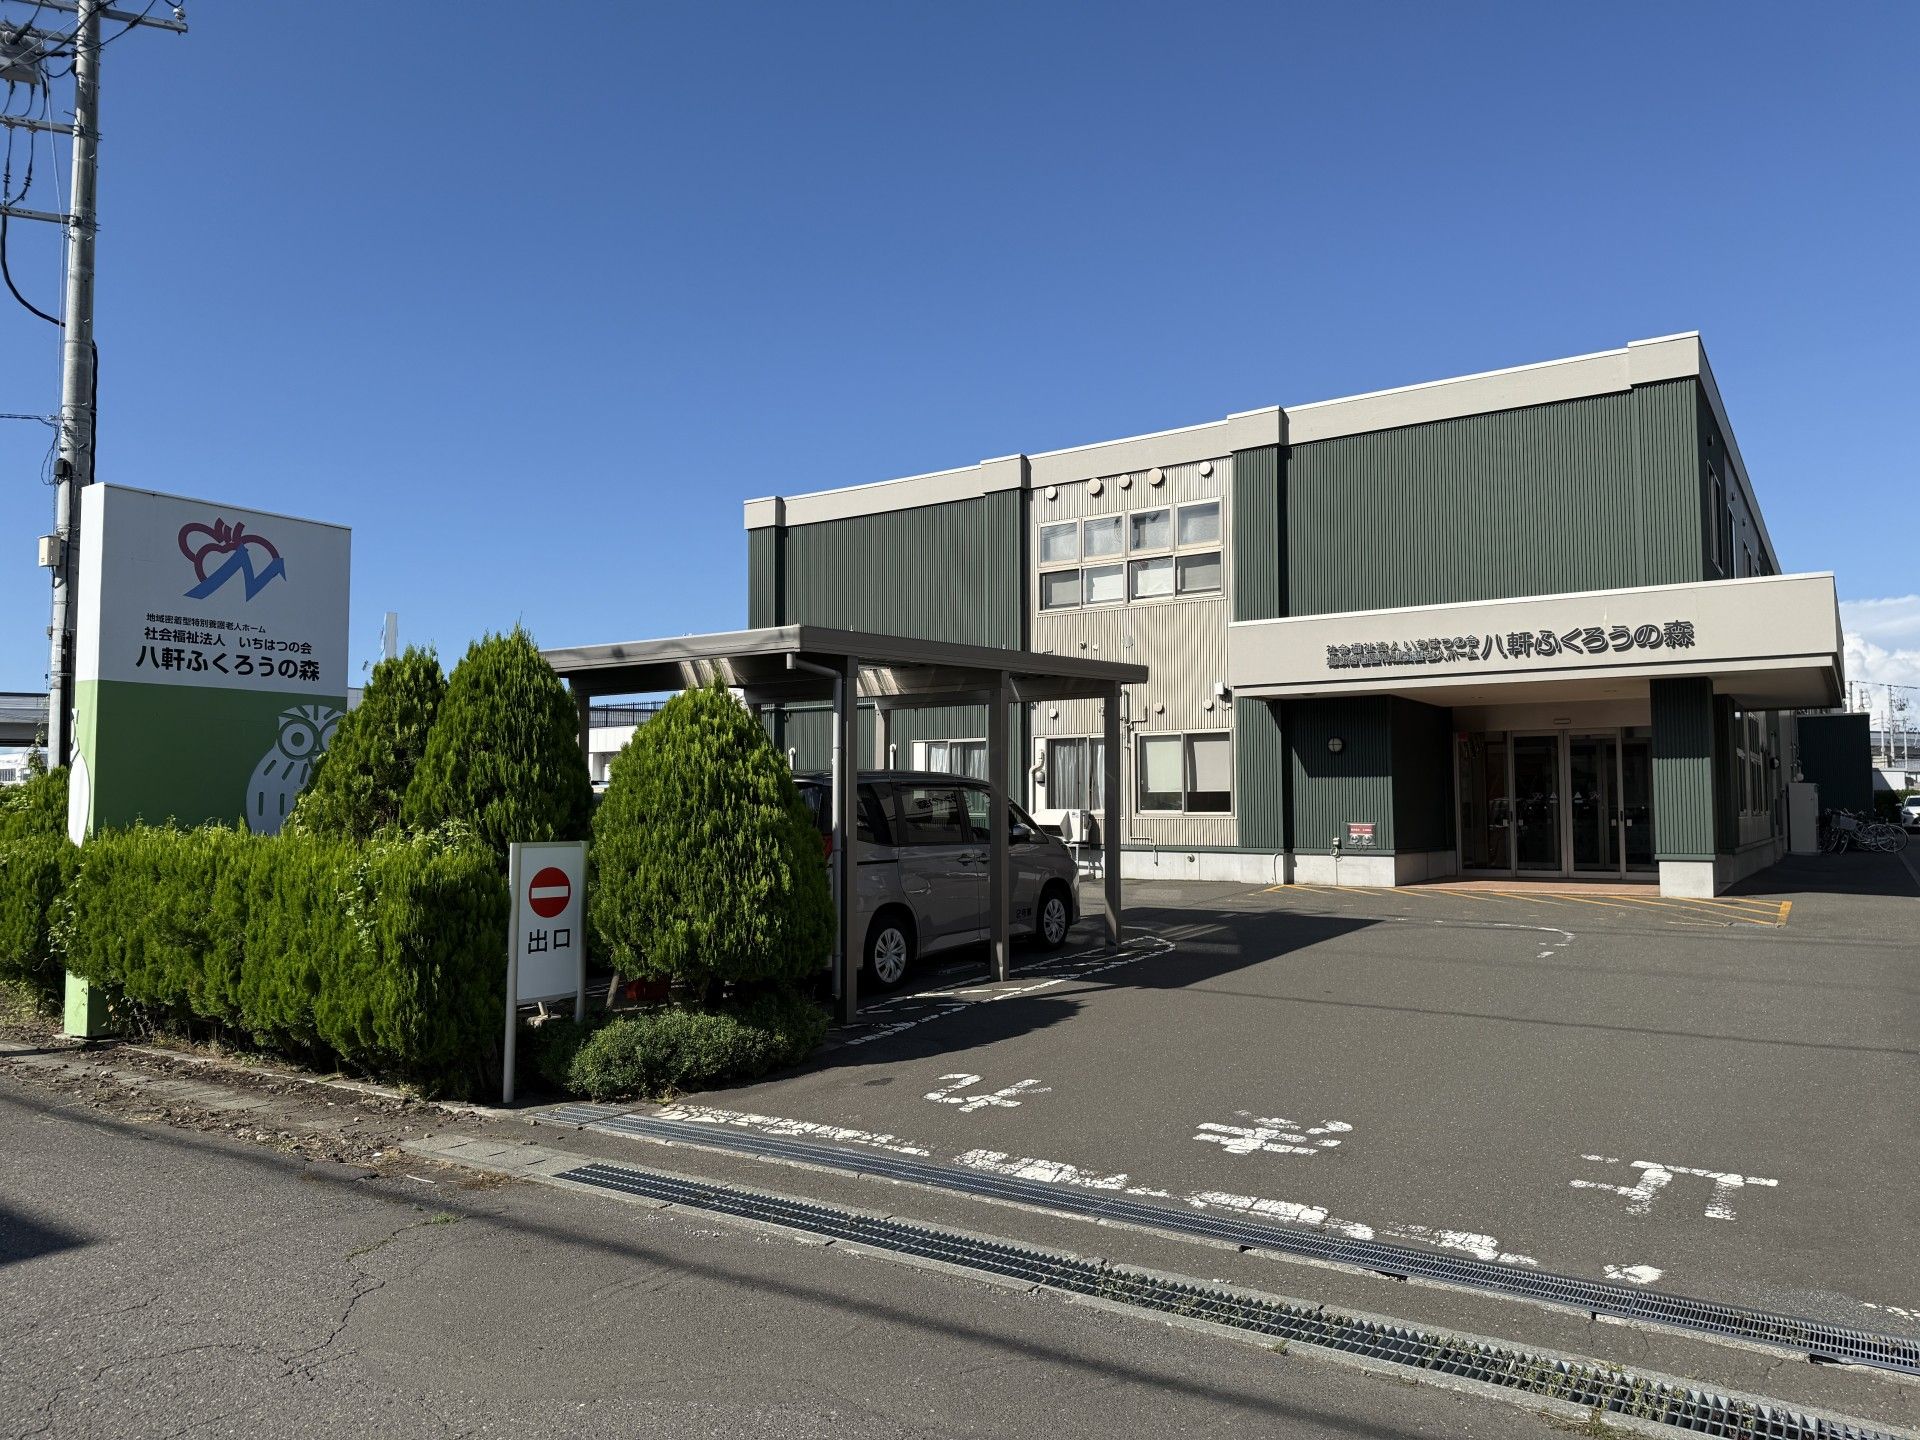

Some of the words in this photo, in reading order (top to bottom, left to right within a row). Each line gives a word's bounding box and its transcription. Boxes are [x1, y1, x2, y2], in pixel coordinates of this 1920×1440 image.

[144, 626, 226, 647] 社会福祉法人
[239, 637, 312, 655] いちはつの会
[1480, 619, 1695, 661] 八軒ふくろうの森
[136, 645, 320, 682] 八軒ふくろうの森
[528, 928, 570, 955] 出口
